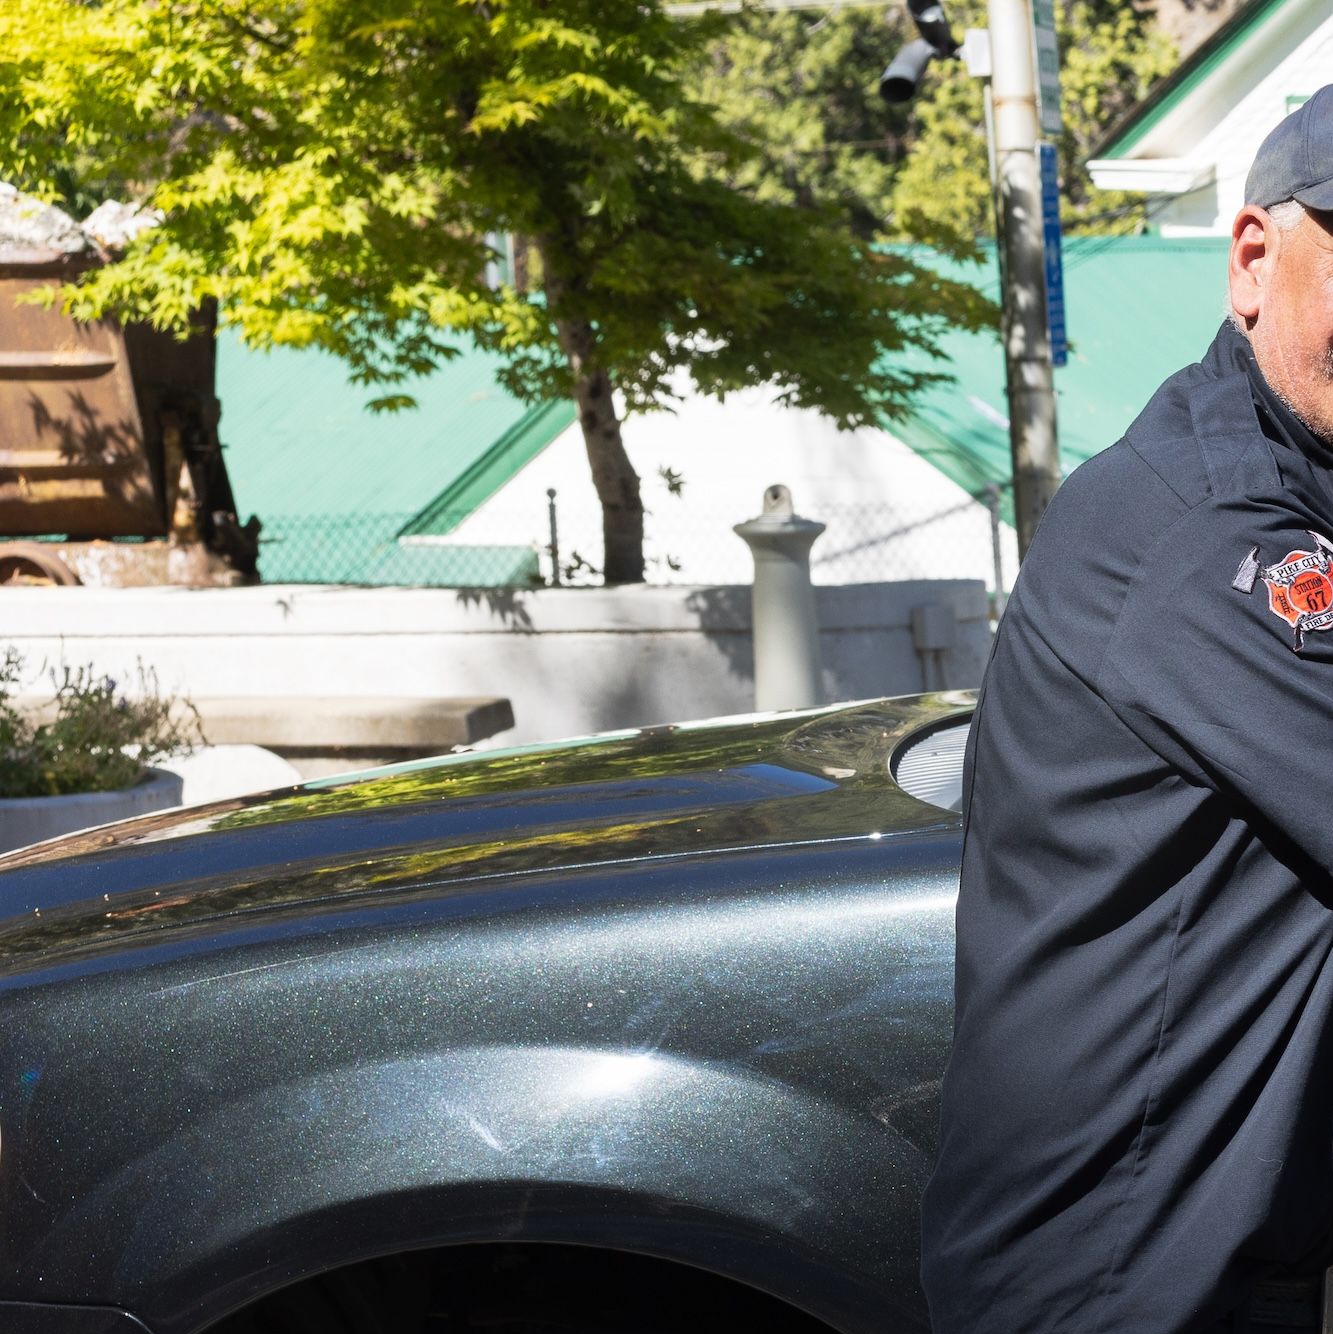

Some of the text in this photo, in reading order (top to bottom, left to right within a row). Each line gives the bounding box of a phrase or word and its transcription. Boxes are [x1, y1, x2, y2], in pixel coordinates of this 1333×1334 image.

[1276, 554, 1322, 578] PIKE CITY
[1294, 576, 1323, 595] STATION
[1305, 590, 1328, 611] 67
[1305, 617, 1324, 630] FIRE
